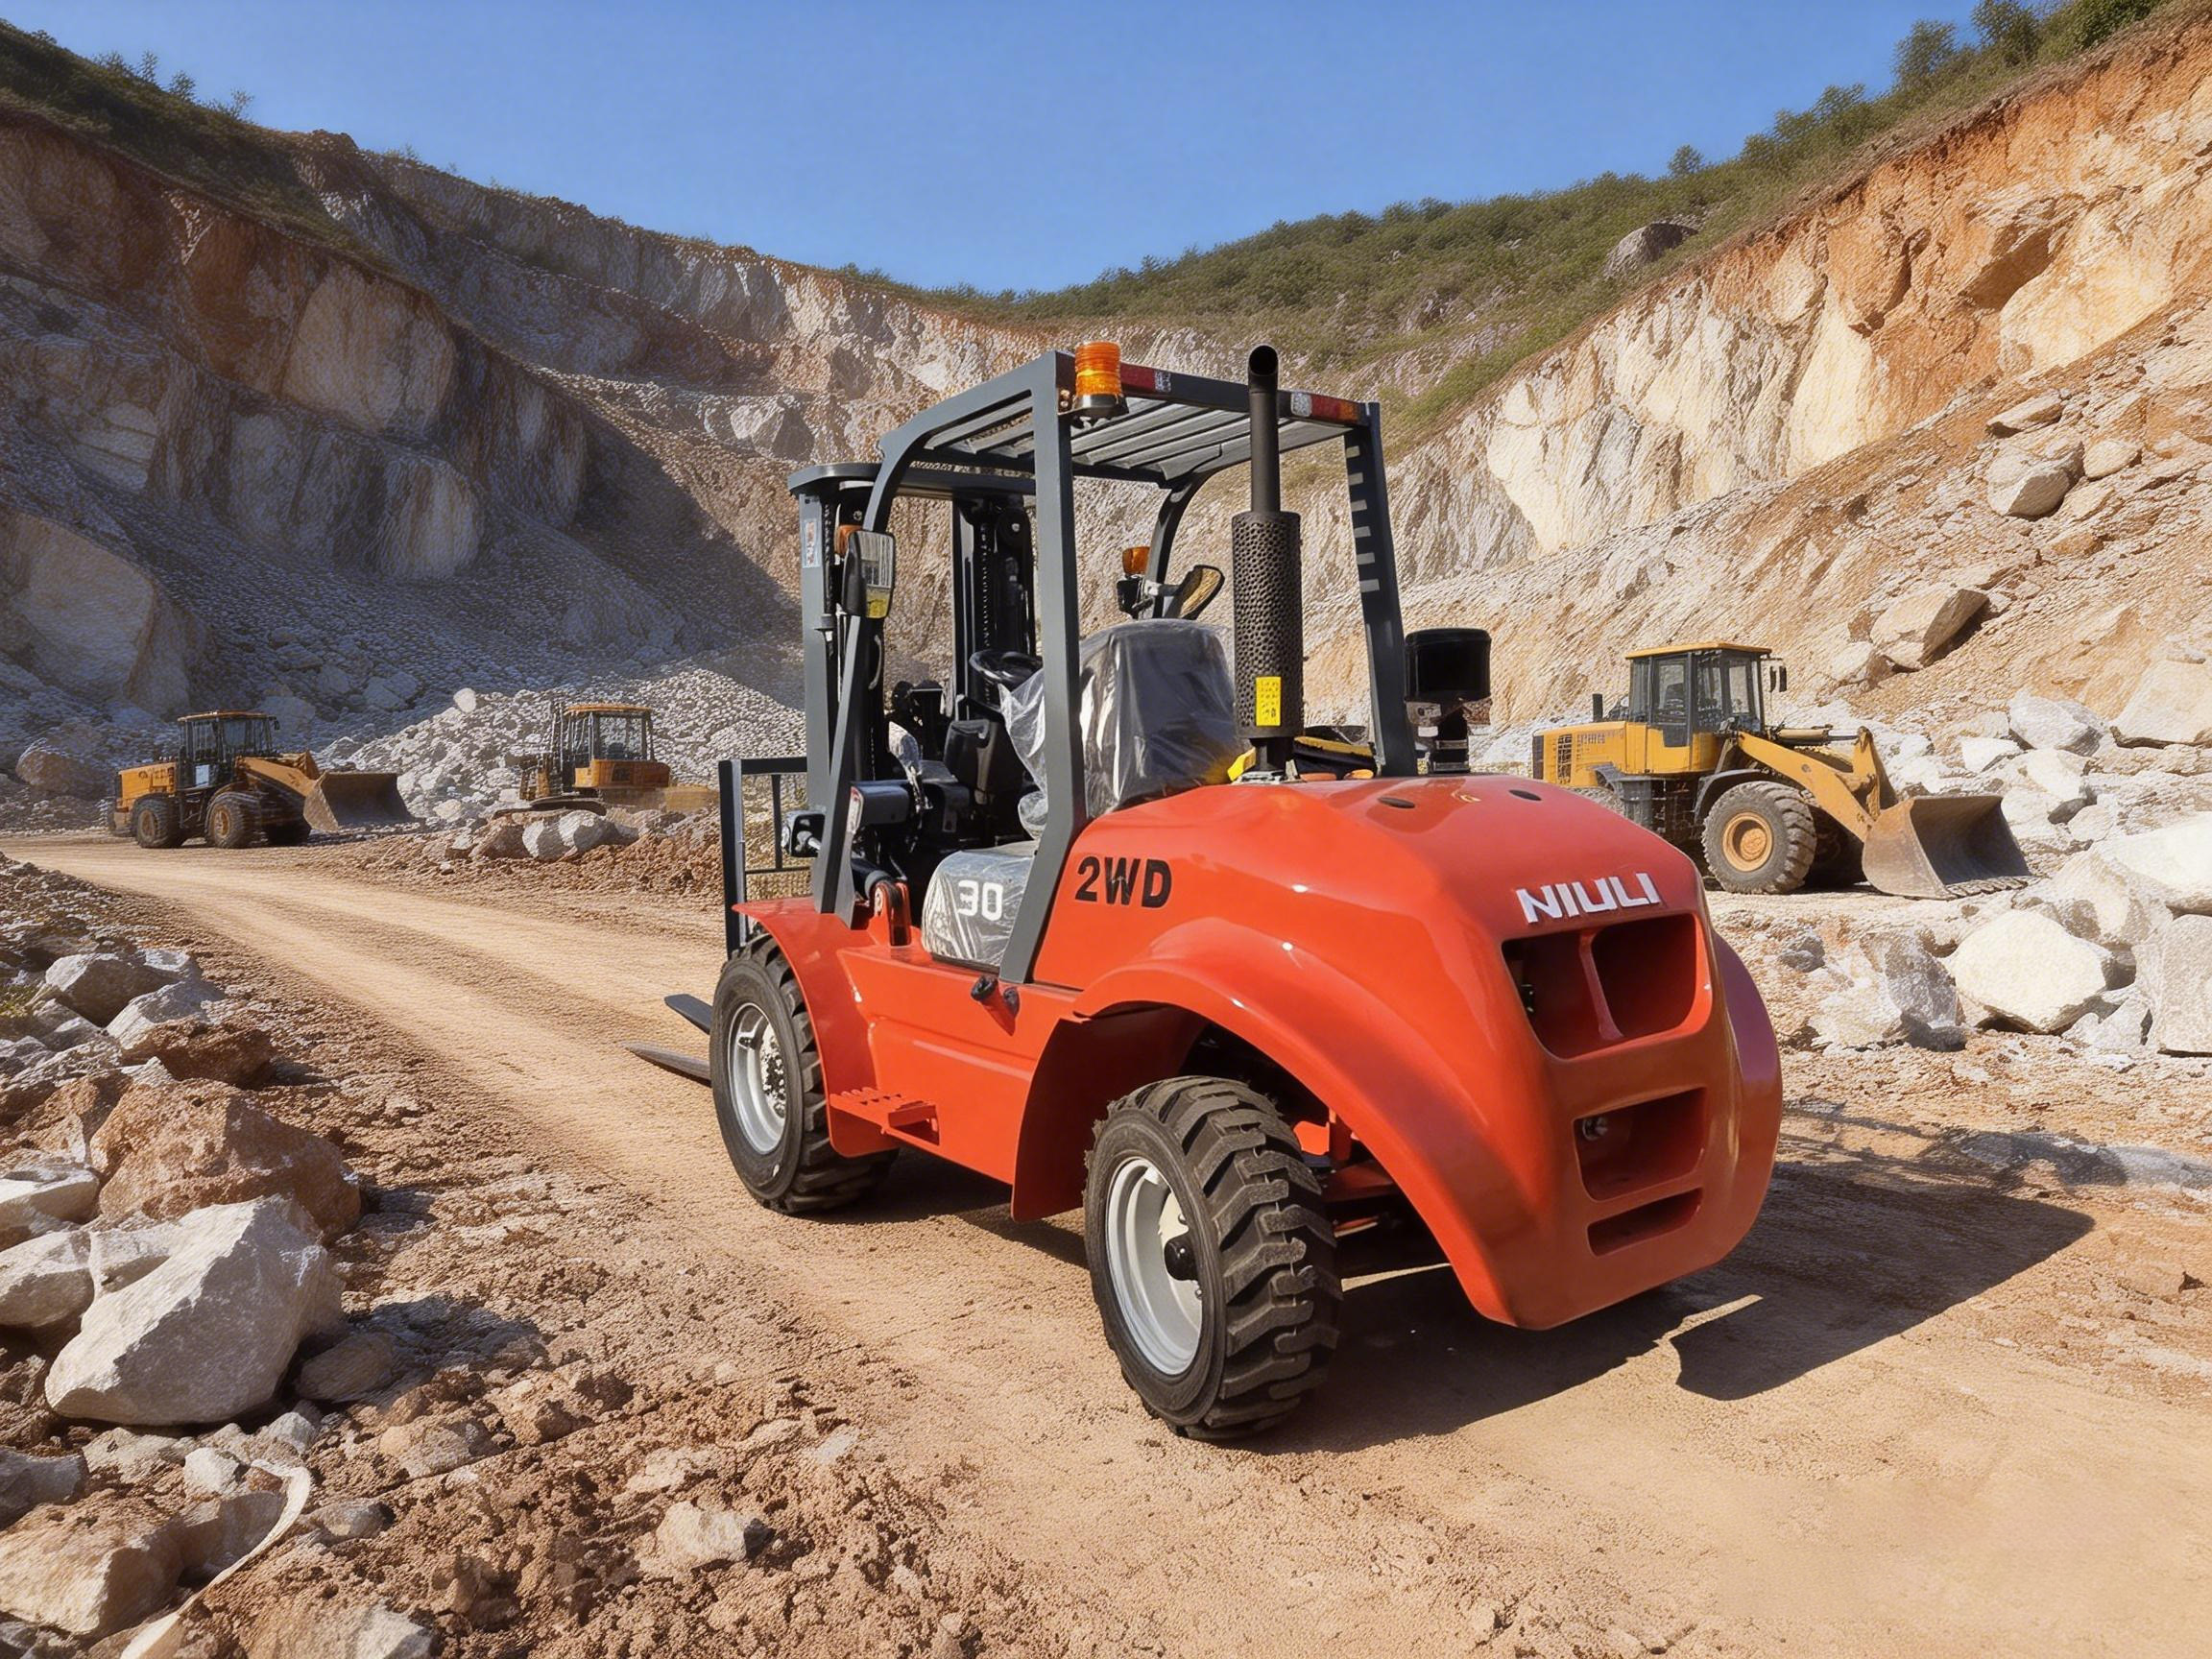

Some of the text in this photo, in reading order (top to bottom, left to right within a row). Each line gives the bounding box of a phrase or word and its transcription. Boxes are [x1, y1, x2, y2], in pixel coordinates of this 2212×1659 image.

[958, 879, 1003, 922] 30
[1075, 855, 1172, 908] 2WD
[1516, 873, 1661, 924] NIULI
